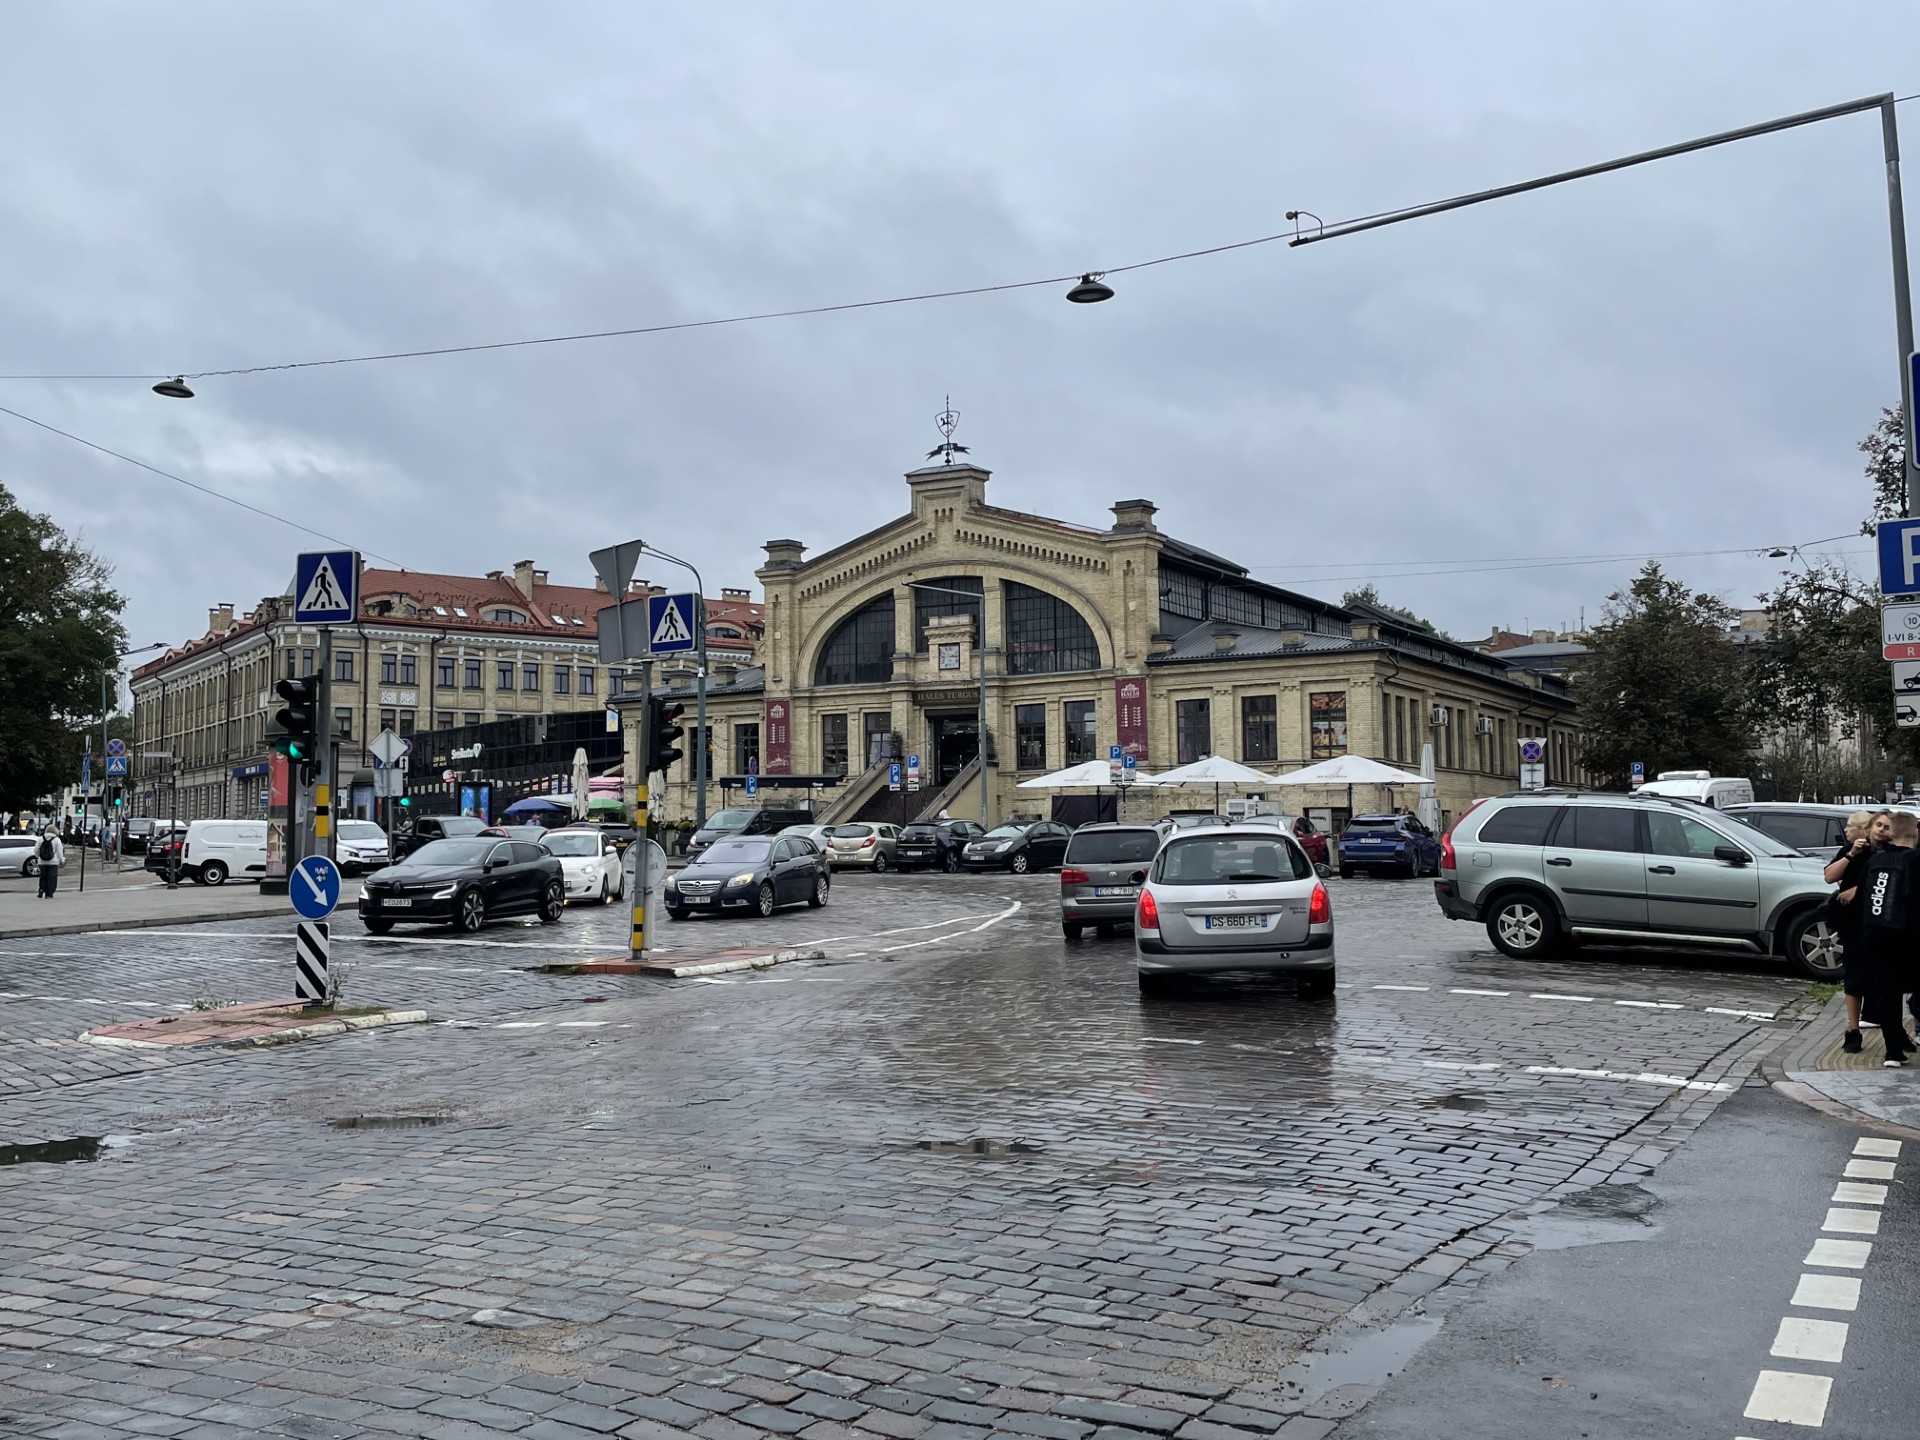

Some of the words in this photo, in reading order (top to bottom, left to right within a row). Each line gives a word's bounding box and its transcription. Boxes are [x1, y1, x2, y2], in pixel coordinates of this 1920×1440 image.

[1908, 647, 1915, 656] R
[947, 691, 978, 699] TURGUS
[1871, 872, 1889, 916] adidas
[1211, 915, 1260, 927] CS-660-FL
